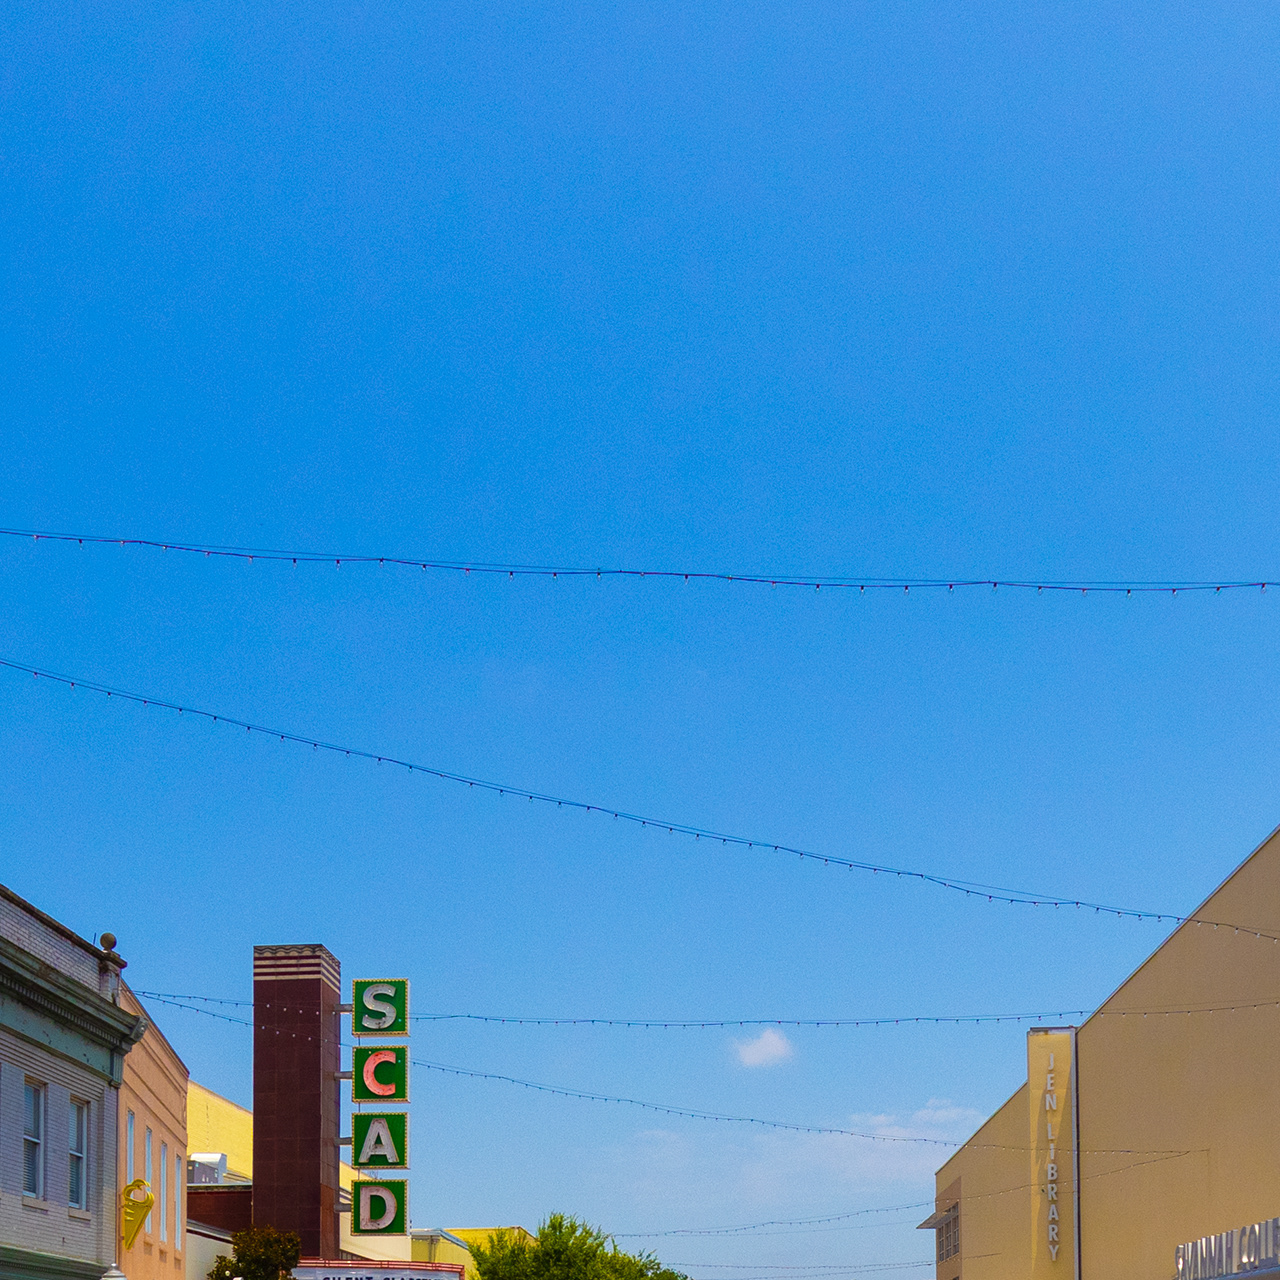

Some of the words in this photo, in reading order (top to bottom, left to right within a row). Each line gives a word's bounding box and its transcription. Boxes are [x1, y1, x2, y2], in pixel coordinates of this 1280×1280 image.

[359, 983, 400, 1230] SCAD
[1045, 1053, 1057, 1110] JEN
[1047, 1123, 1060, 1262] LIBRARY
